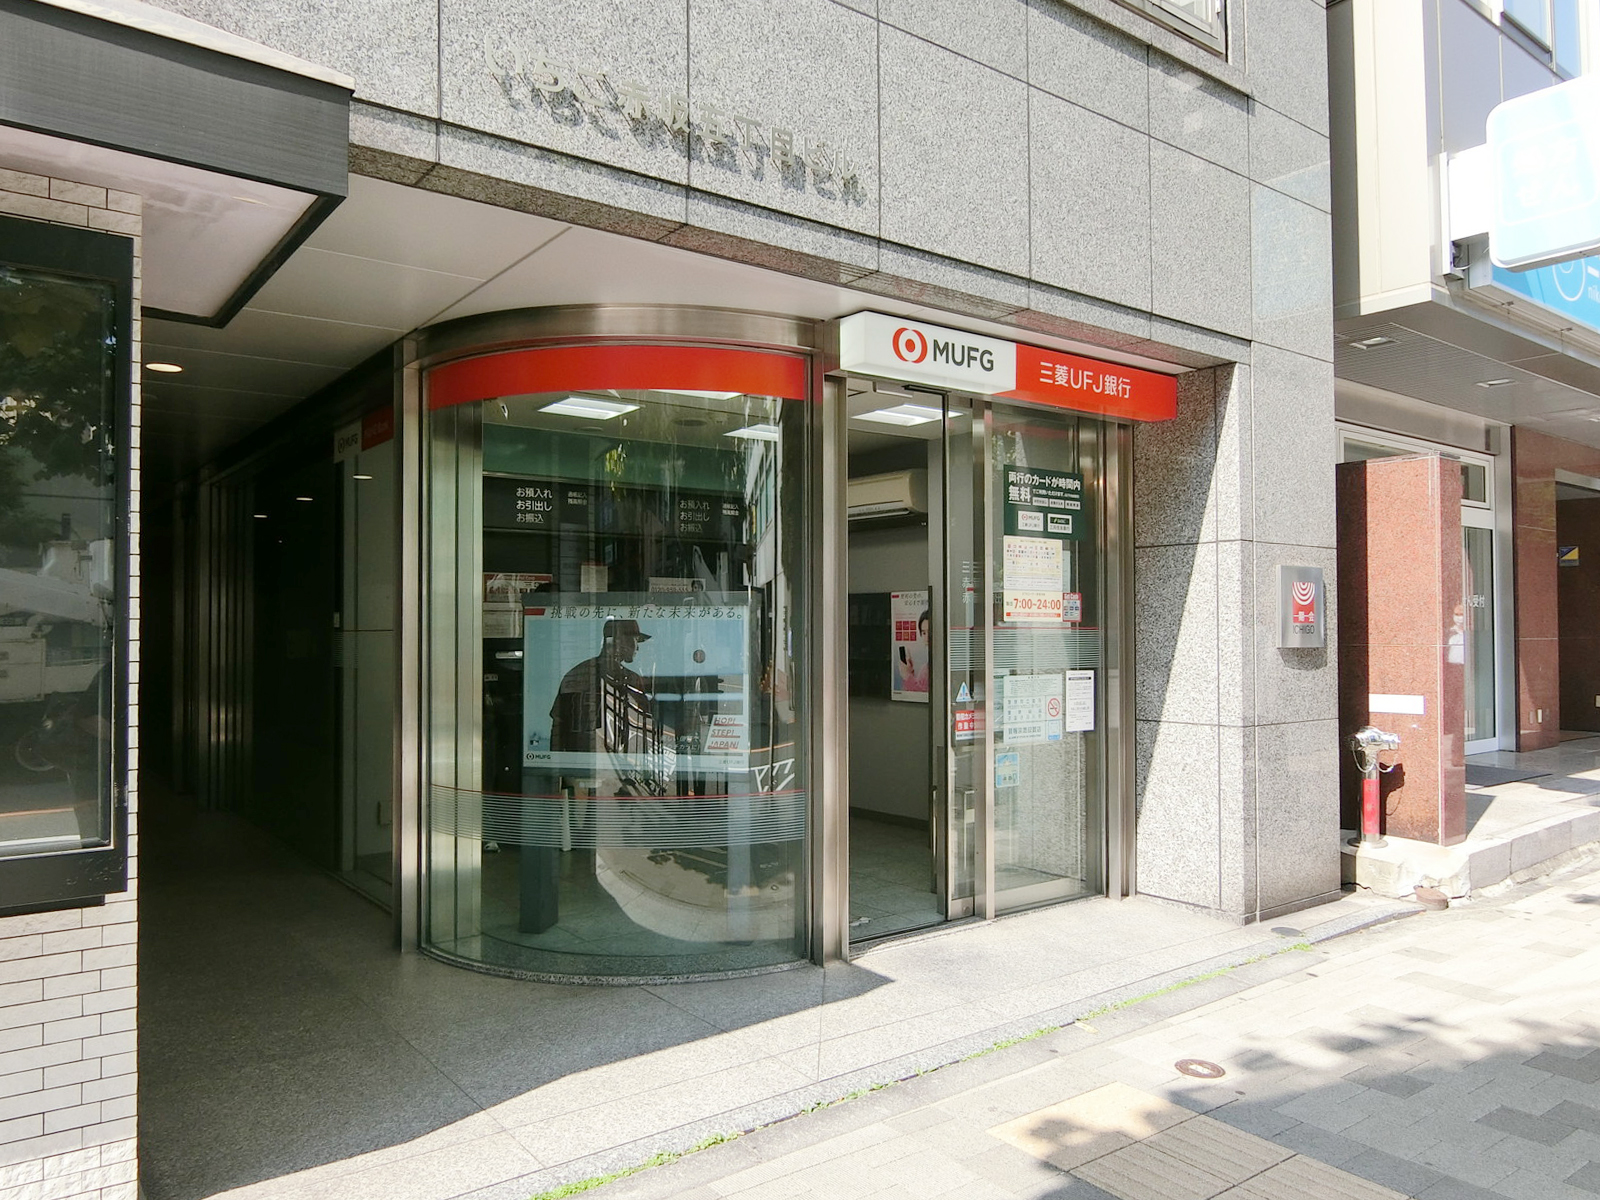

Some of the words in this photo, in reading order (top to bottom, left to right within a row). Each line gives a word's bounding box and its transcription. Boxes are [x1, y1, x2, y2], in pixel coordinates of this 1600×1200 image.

[485, 35, 859, 180] いちご赤坂五丁目ビル
[933, 338, 994, 373] MUFG
[1039, 361, 1131, 399] 三菱UFJ銀行
[1008, 471, 1081, 491] 両行のカードが時間内
[516, 487, 553, 499] お預入れ
[1008, 485, 1031, 502] 無料
[516, 499, 553, 512] お引出し
[680, 500, 710, 511] お預入れ
[516, 513, 544, 524] お振込
[680, 511, 710, 522] お引出し
[550, 604, 743, 620] 挑戦の先に、新たな未来がある。
[1292, 625, 1315, 635] ICHIGO
[714, 717, 736, 725] HOP!
[711, 729, 735, 737] STEP!
[709, 740, 739, 749] JAPAN!
